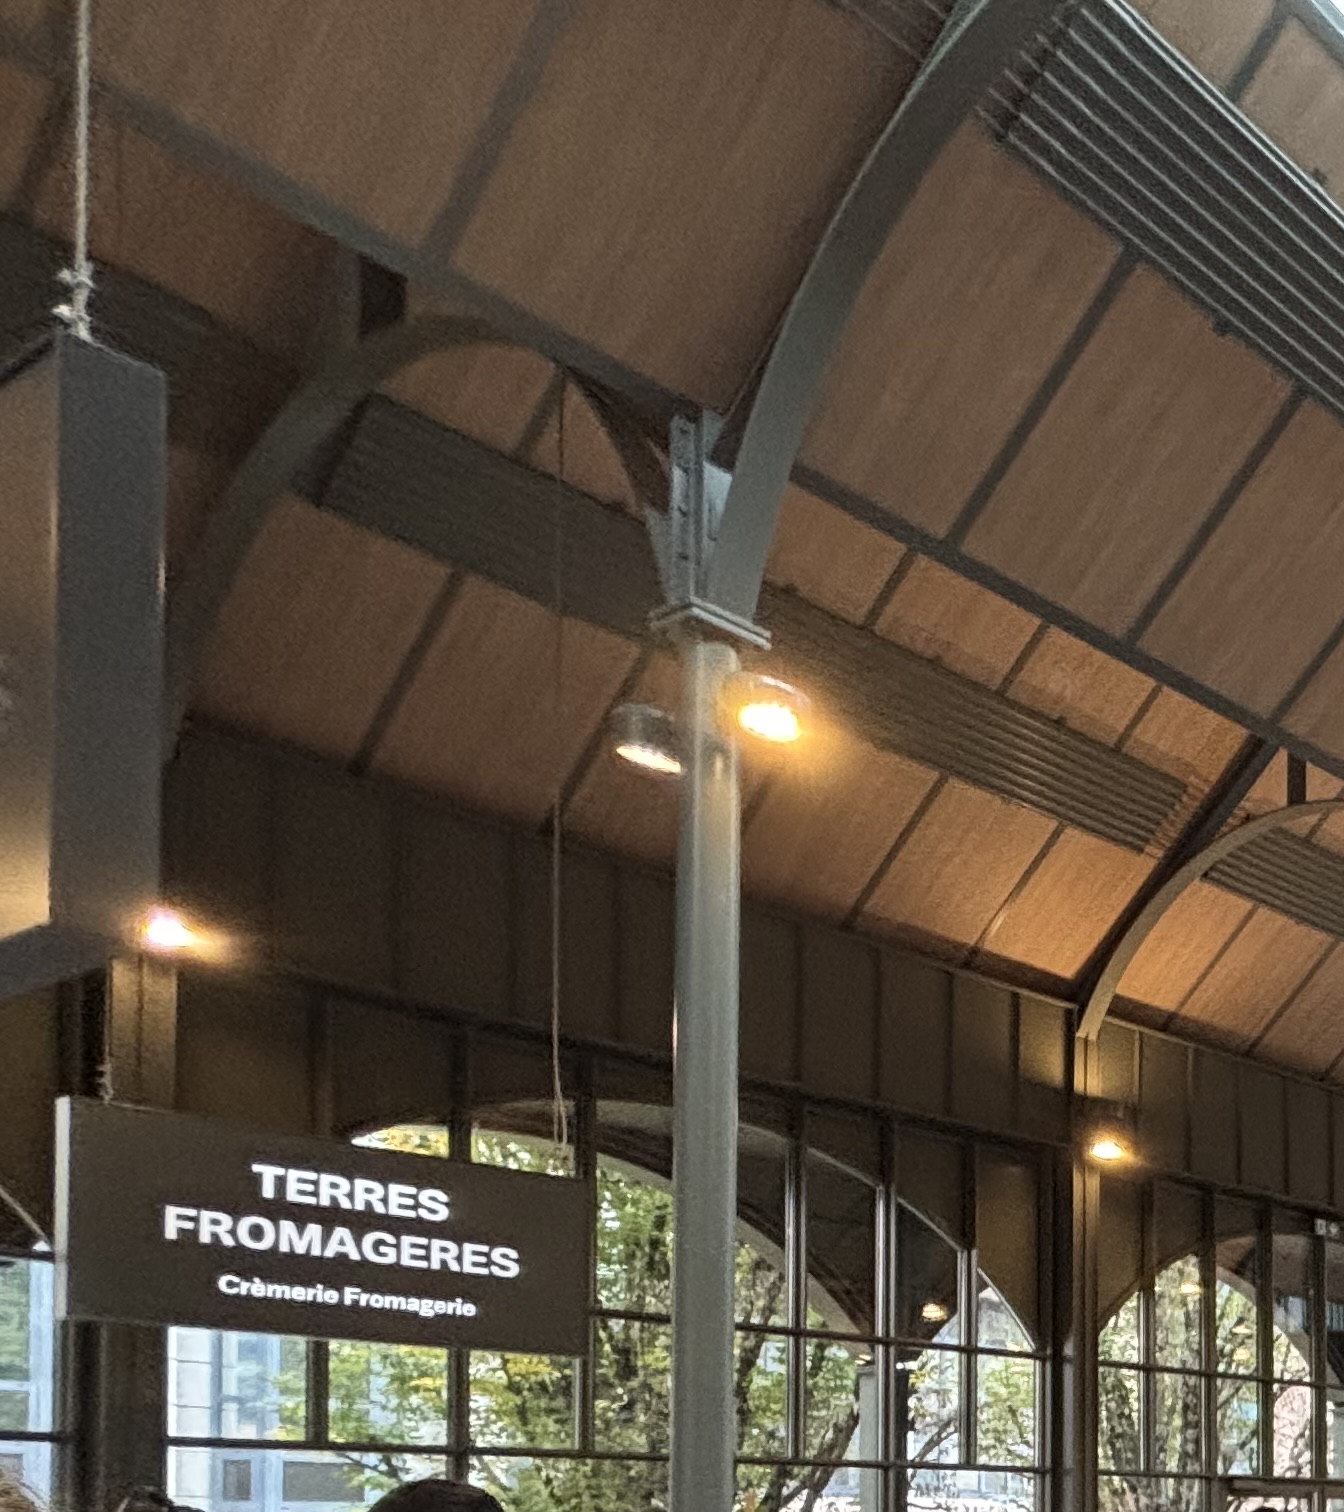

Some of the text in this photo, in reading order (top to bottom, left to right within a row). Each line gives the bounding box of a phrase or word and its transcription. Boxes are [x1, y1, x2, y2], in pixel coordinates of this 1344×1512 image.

[250, 1162, 451, 1222] TERRES
[163, 1205, 521, 1280] FROMAGERES
[218, 1273, 477, 1319] Crèmerie Fromagerie
